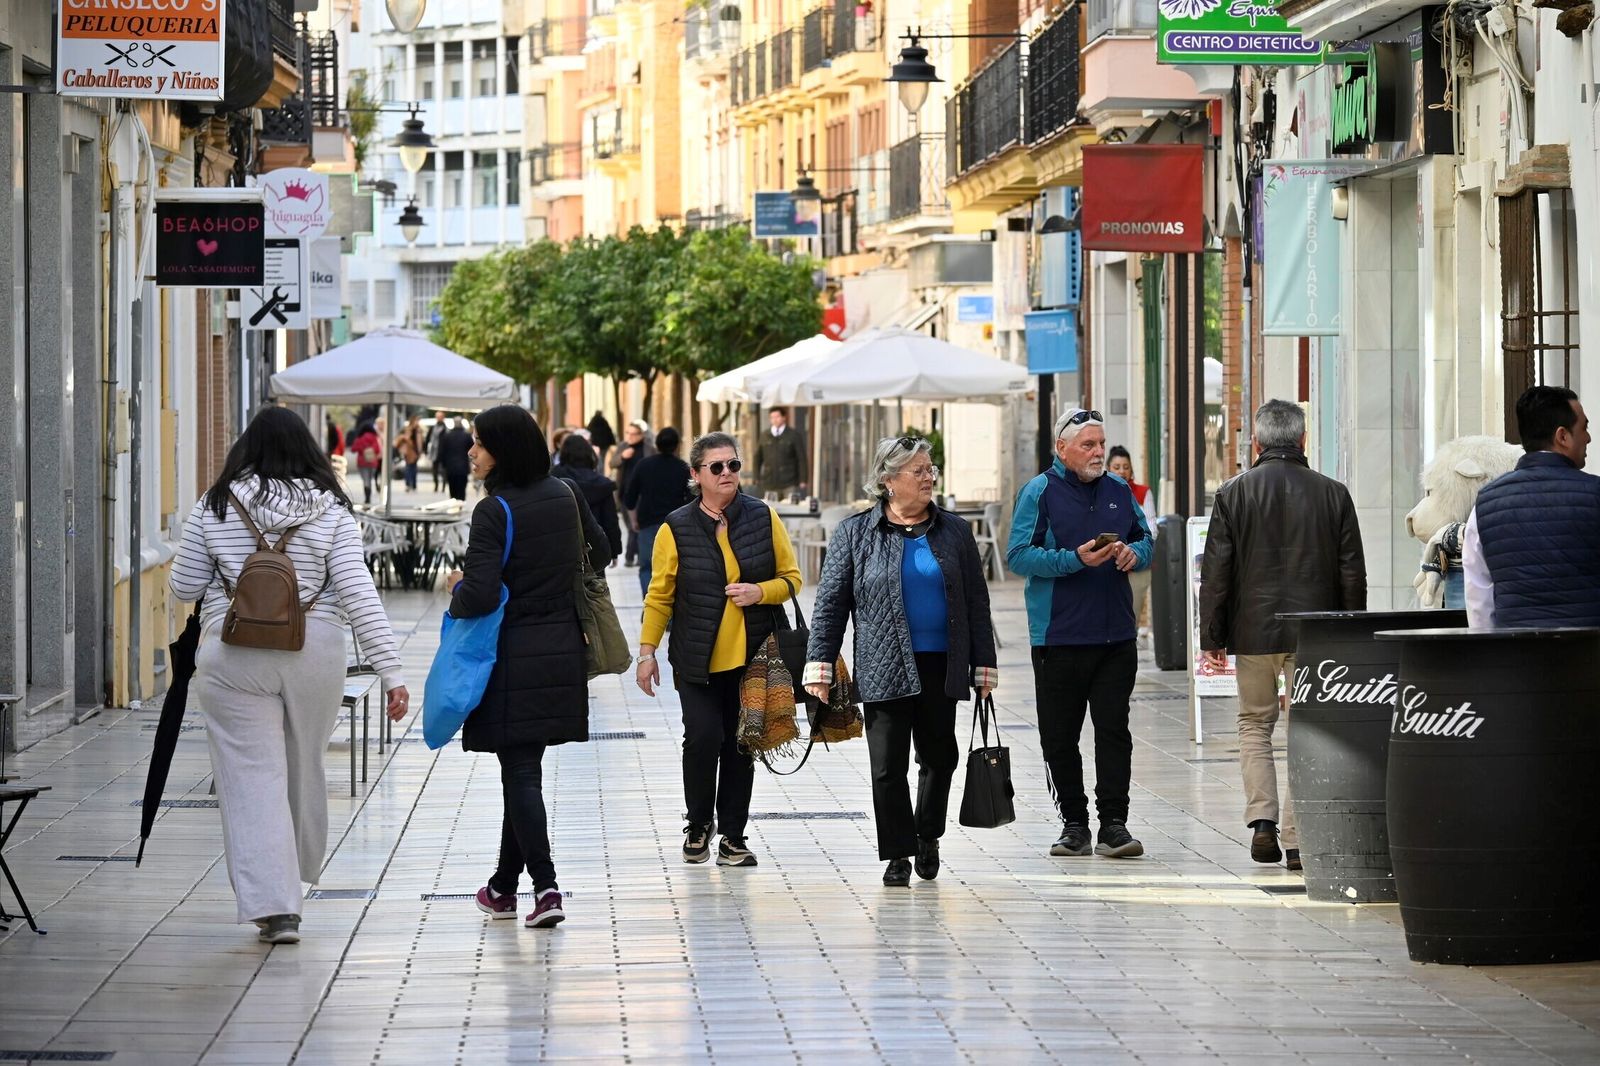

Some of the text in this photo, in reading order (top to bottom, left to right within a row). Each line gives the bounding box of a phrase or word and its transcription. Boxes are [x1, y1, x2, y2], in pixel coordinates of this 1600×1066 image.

[69, 0, 216, 11] CANSECOS
[66, 15, 218, 36] PELUQUERIA
[1173, 36, 1315, 50] CENTRO DIETETICO
[63, 69, 219, 94] Caballeros y Niños
[1101, 221, 1184, 235] PRONOVIAS
[1306, 181, 1318, 327] HERBOLARIO
[162, 265, 188, 273] LOLA
[190, 265, 257, 273] CASADEMUNT
[312, 270, 334, 283] ika
[1290, 659, 1399, 705] La Guita
[1400, 685, 1485, 739] Guita
